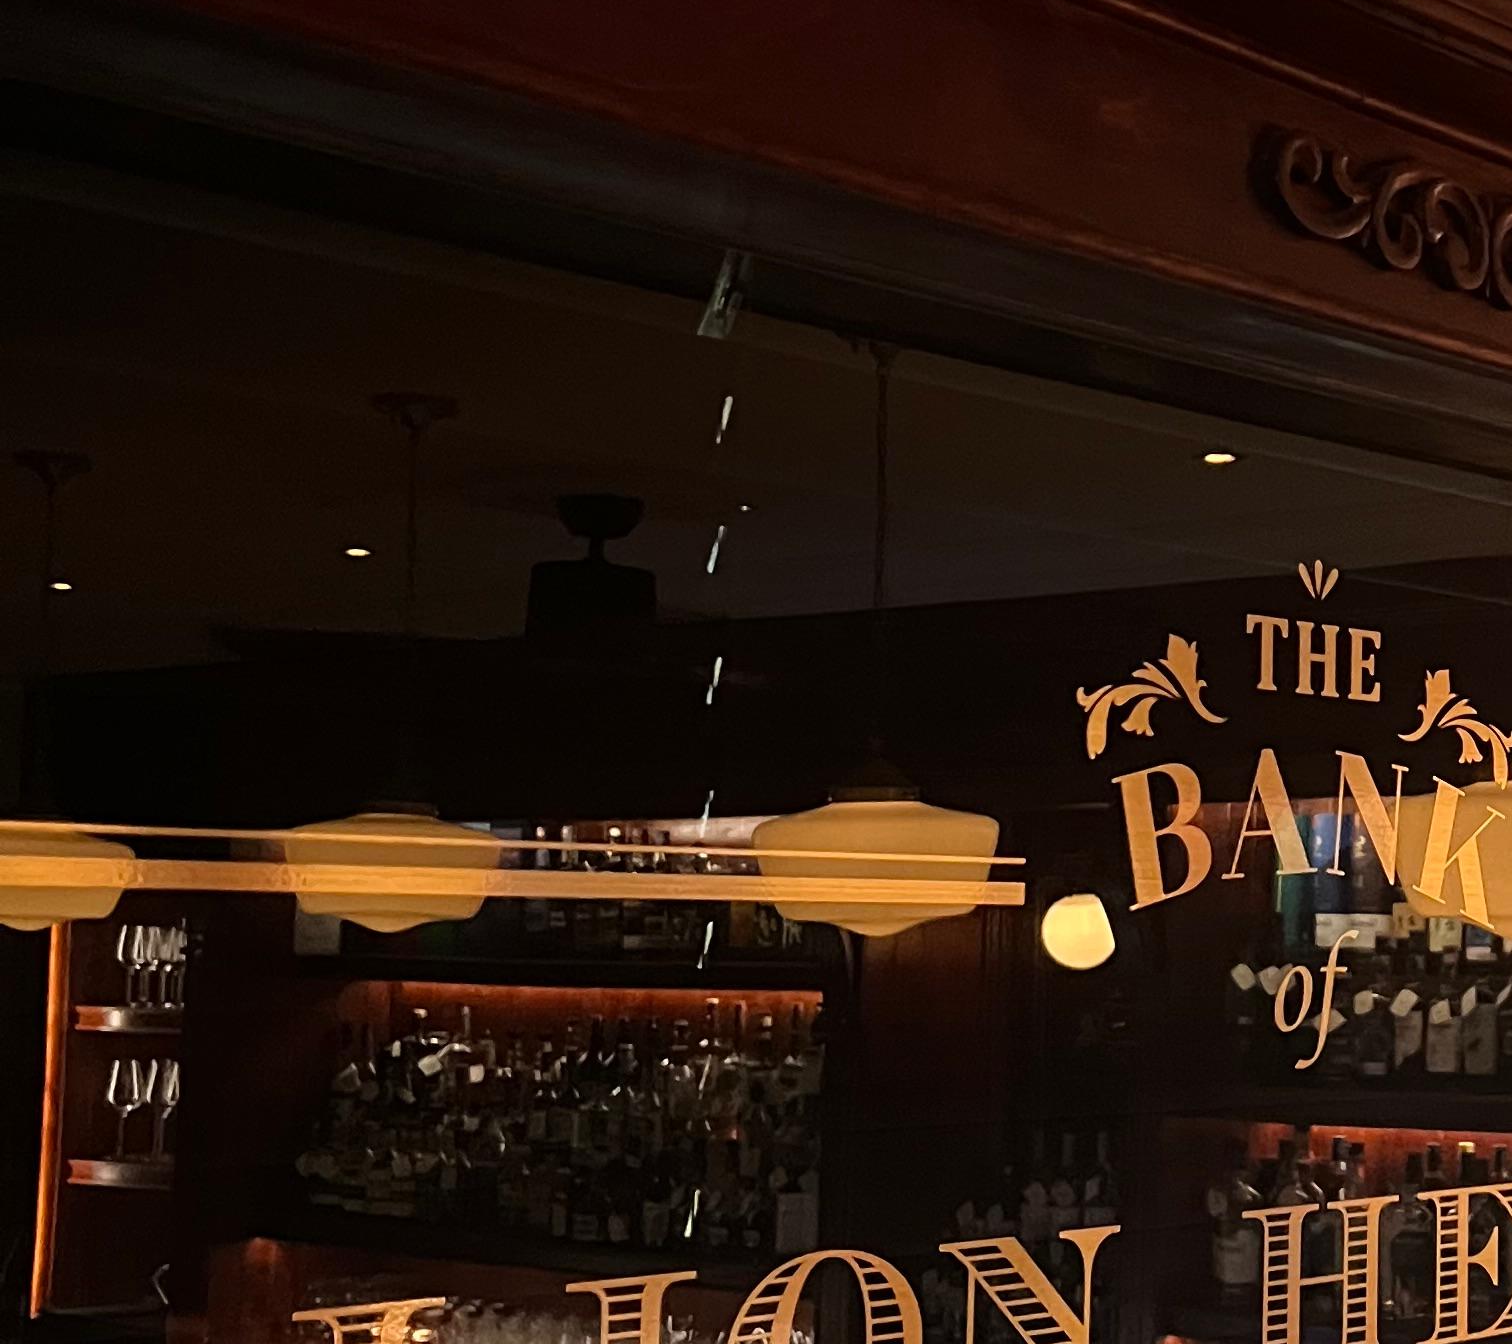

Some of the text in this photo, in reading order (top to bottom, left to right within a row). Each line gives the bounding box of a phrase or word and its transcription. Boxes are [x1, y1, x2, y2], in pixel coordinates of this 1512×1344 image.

[1246, 613, 1382, 703] THE
[1111, 747, 1506, 930] BANK
[1273, 929, 1360, 1070] of
